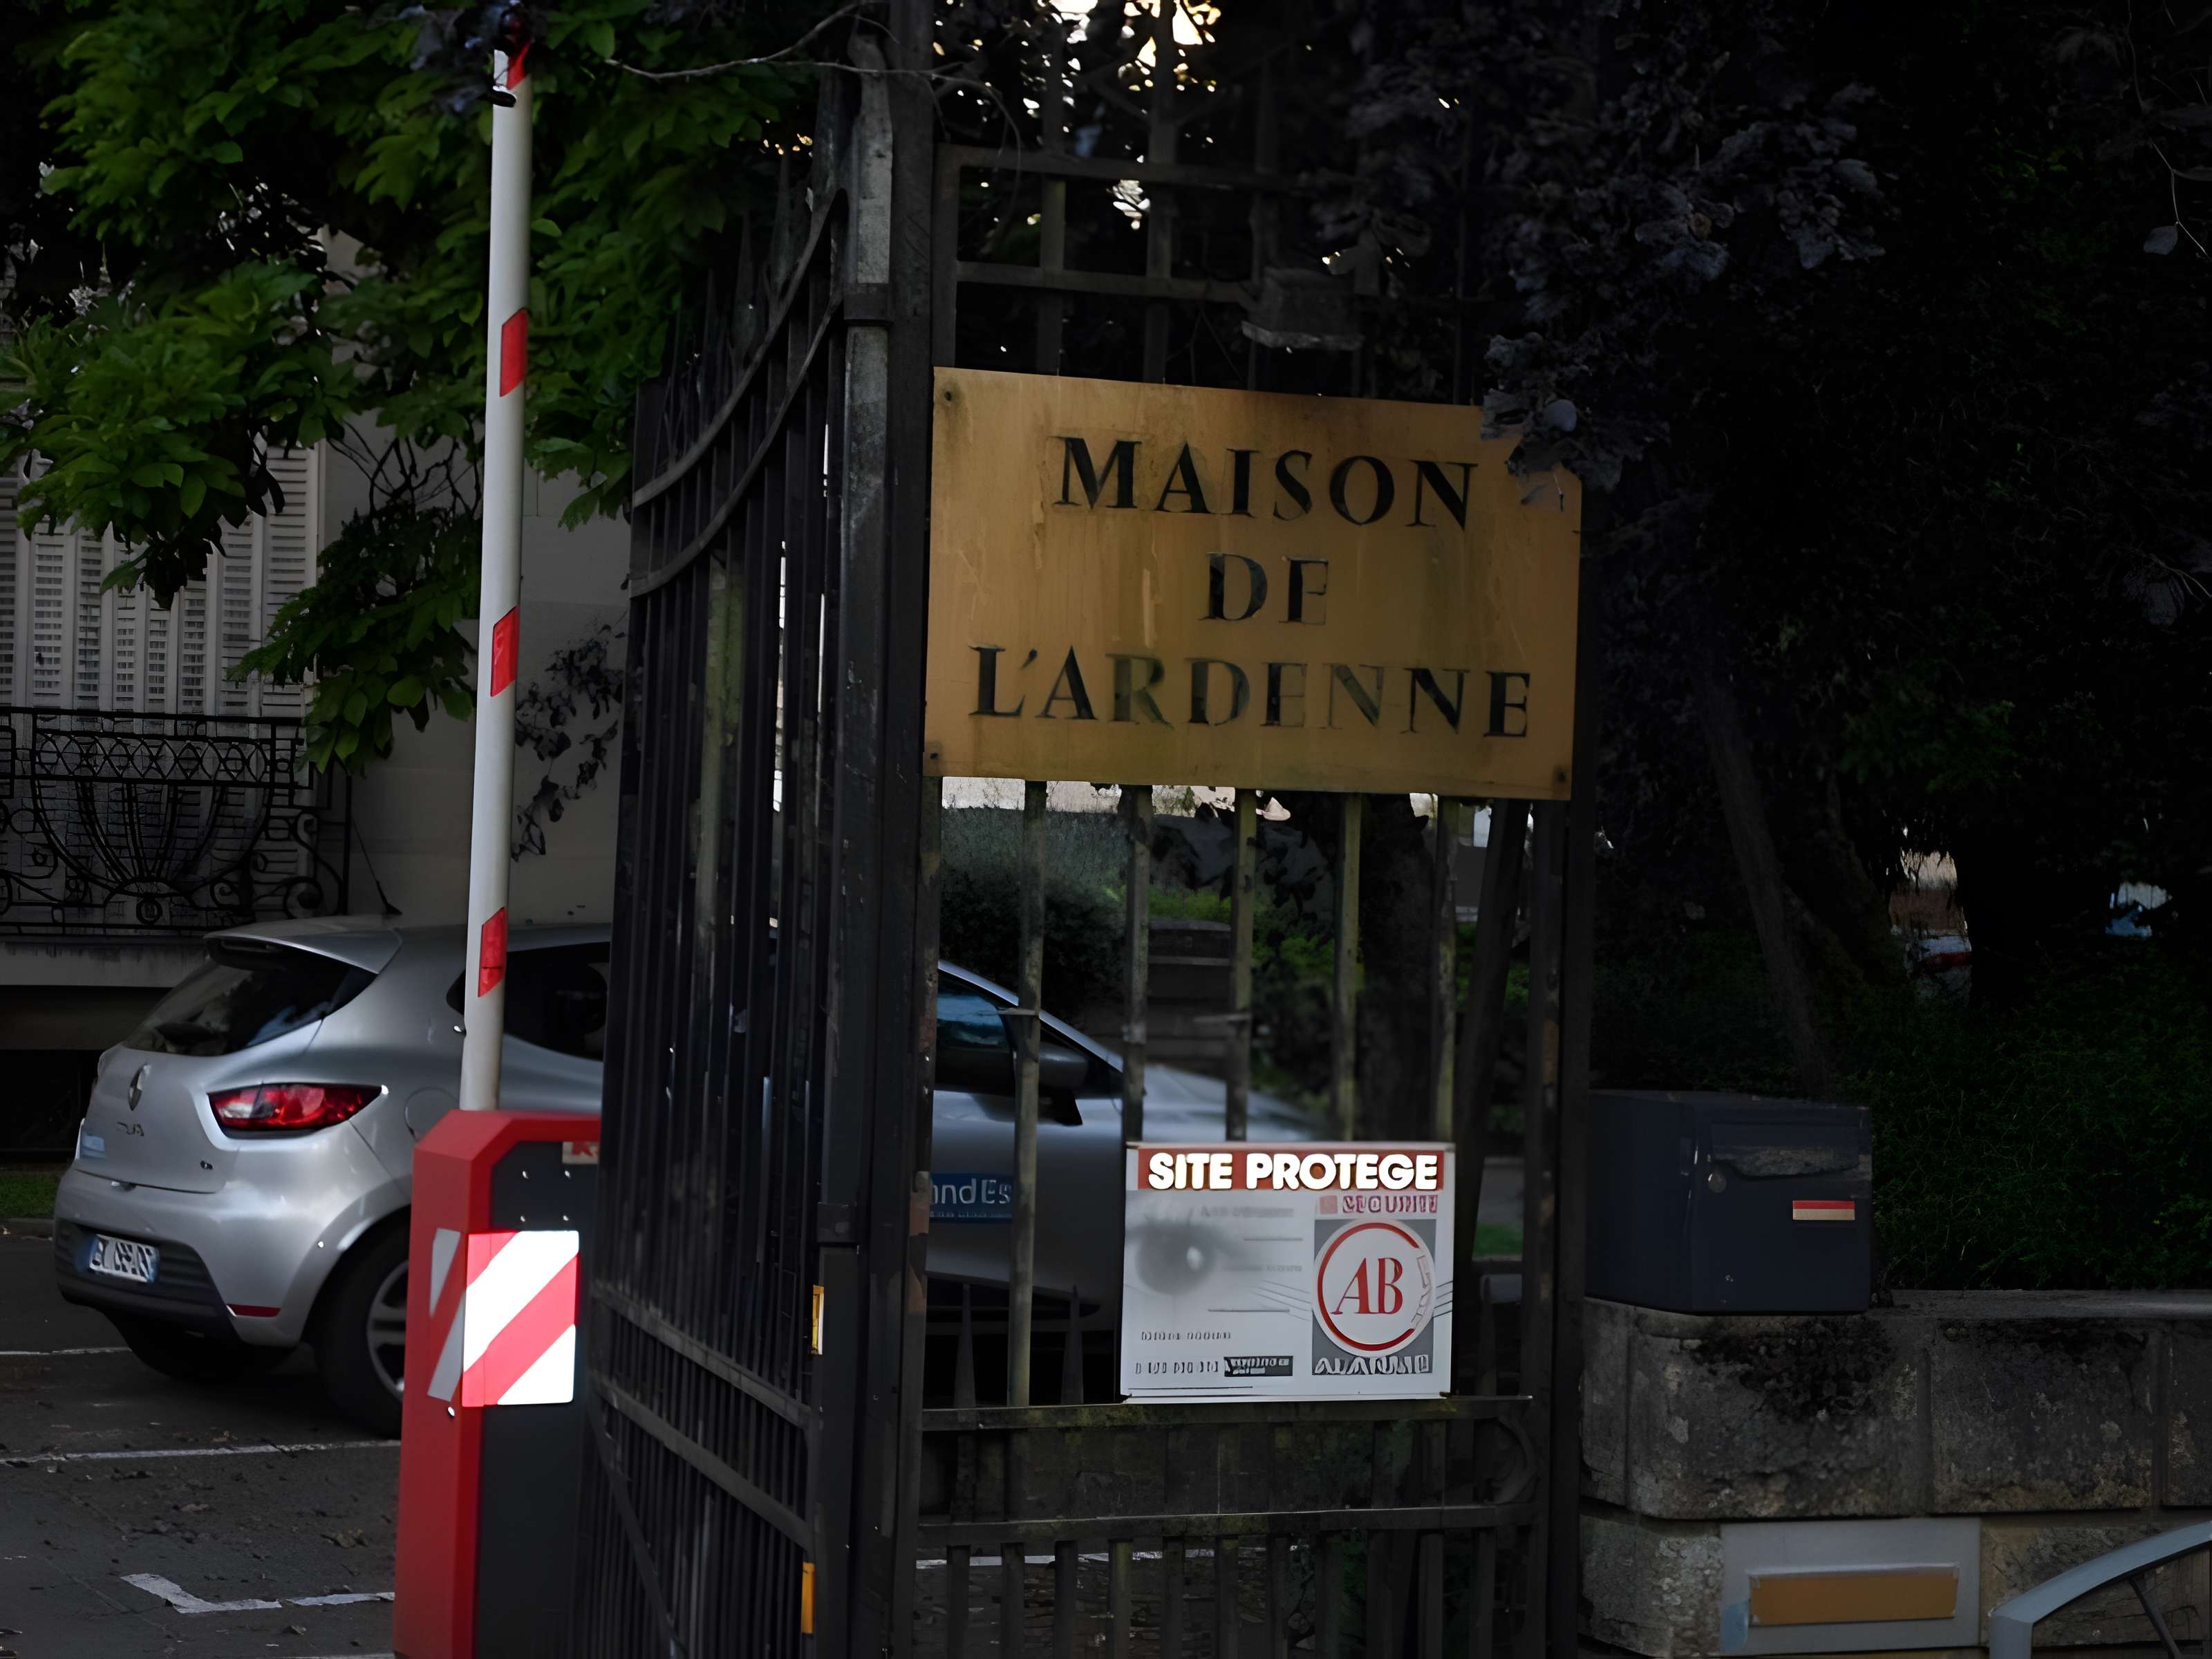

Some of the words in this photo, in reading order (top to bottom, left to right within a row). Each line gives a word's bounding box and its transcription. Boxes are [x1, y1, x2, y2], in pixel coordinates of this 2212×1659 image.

[1050, 435, 1479, 530] MAISON
[1199, 552, 1329, 626] DE
[968, 644, 1531, 738] L'ARDENNE
[1147, 1152, 1233, 1190] SITE
[1246, 1152, 1439, 1191] PROTEGE
[1331, 1257, 1403, 1315] AB
